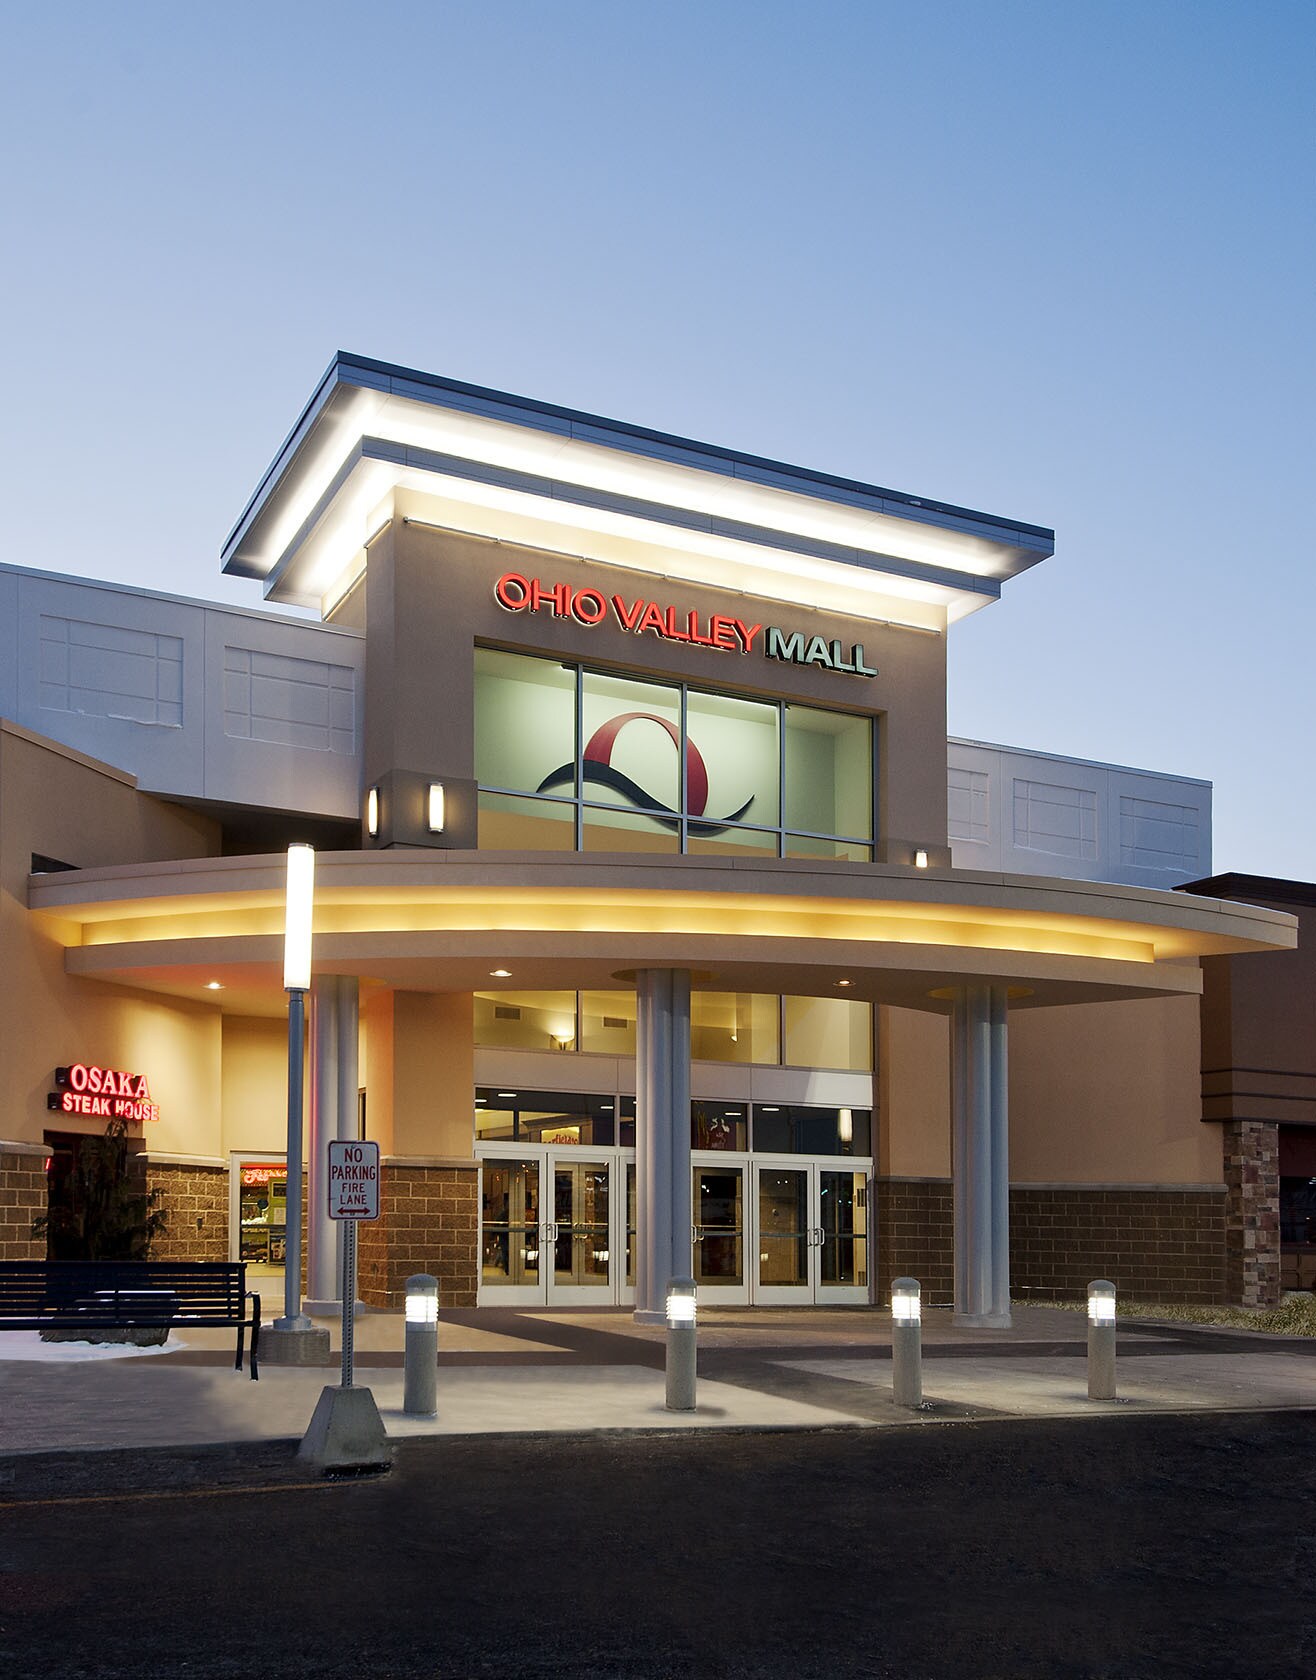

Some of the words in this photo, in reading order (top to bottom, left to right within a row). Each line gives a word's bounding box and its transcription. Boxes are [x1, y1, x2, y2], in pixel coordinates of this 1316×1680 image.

[495, 573, 608, 626] OHIO
[611, 595, 762, 654] VALLEY
[765, 627, 878, 677] MALL
[71, 1064, 150, 1098] OSAKA
[63, 1092, 111, 1116] STEAK
[115, 1099, 160, 1121] HOUSE
[344, 1148, 363, 1163] NO
[331, 1165, 376, 1181] PARKING
[342, 1182, 365, 1193] FIRE
[340, 1194, 367, 1205] LANE
